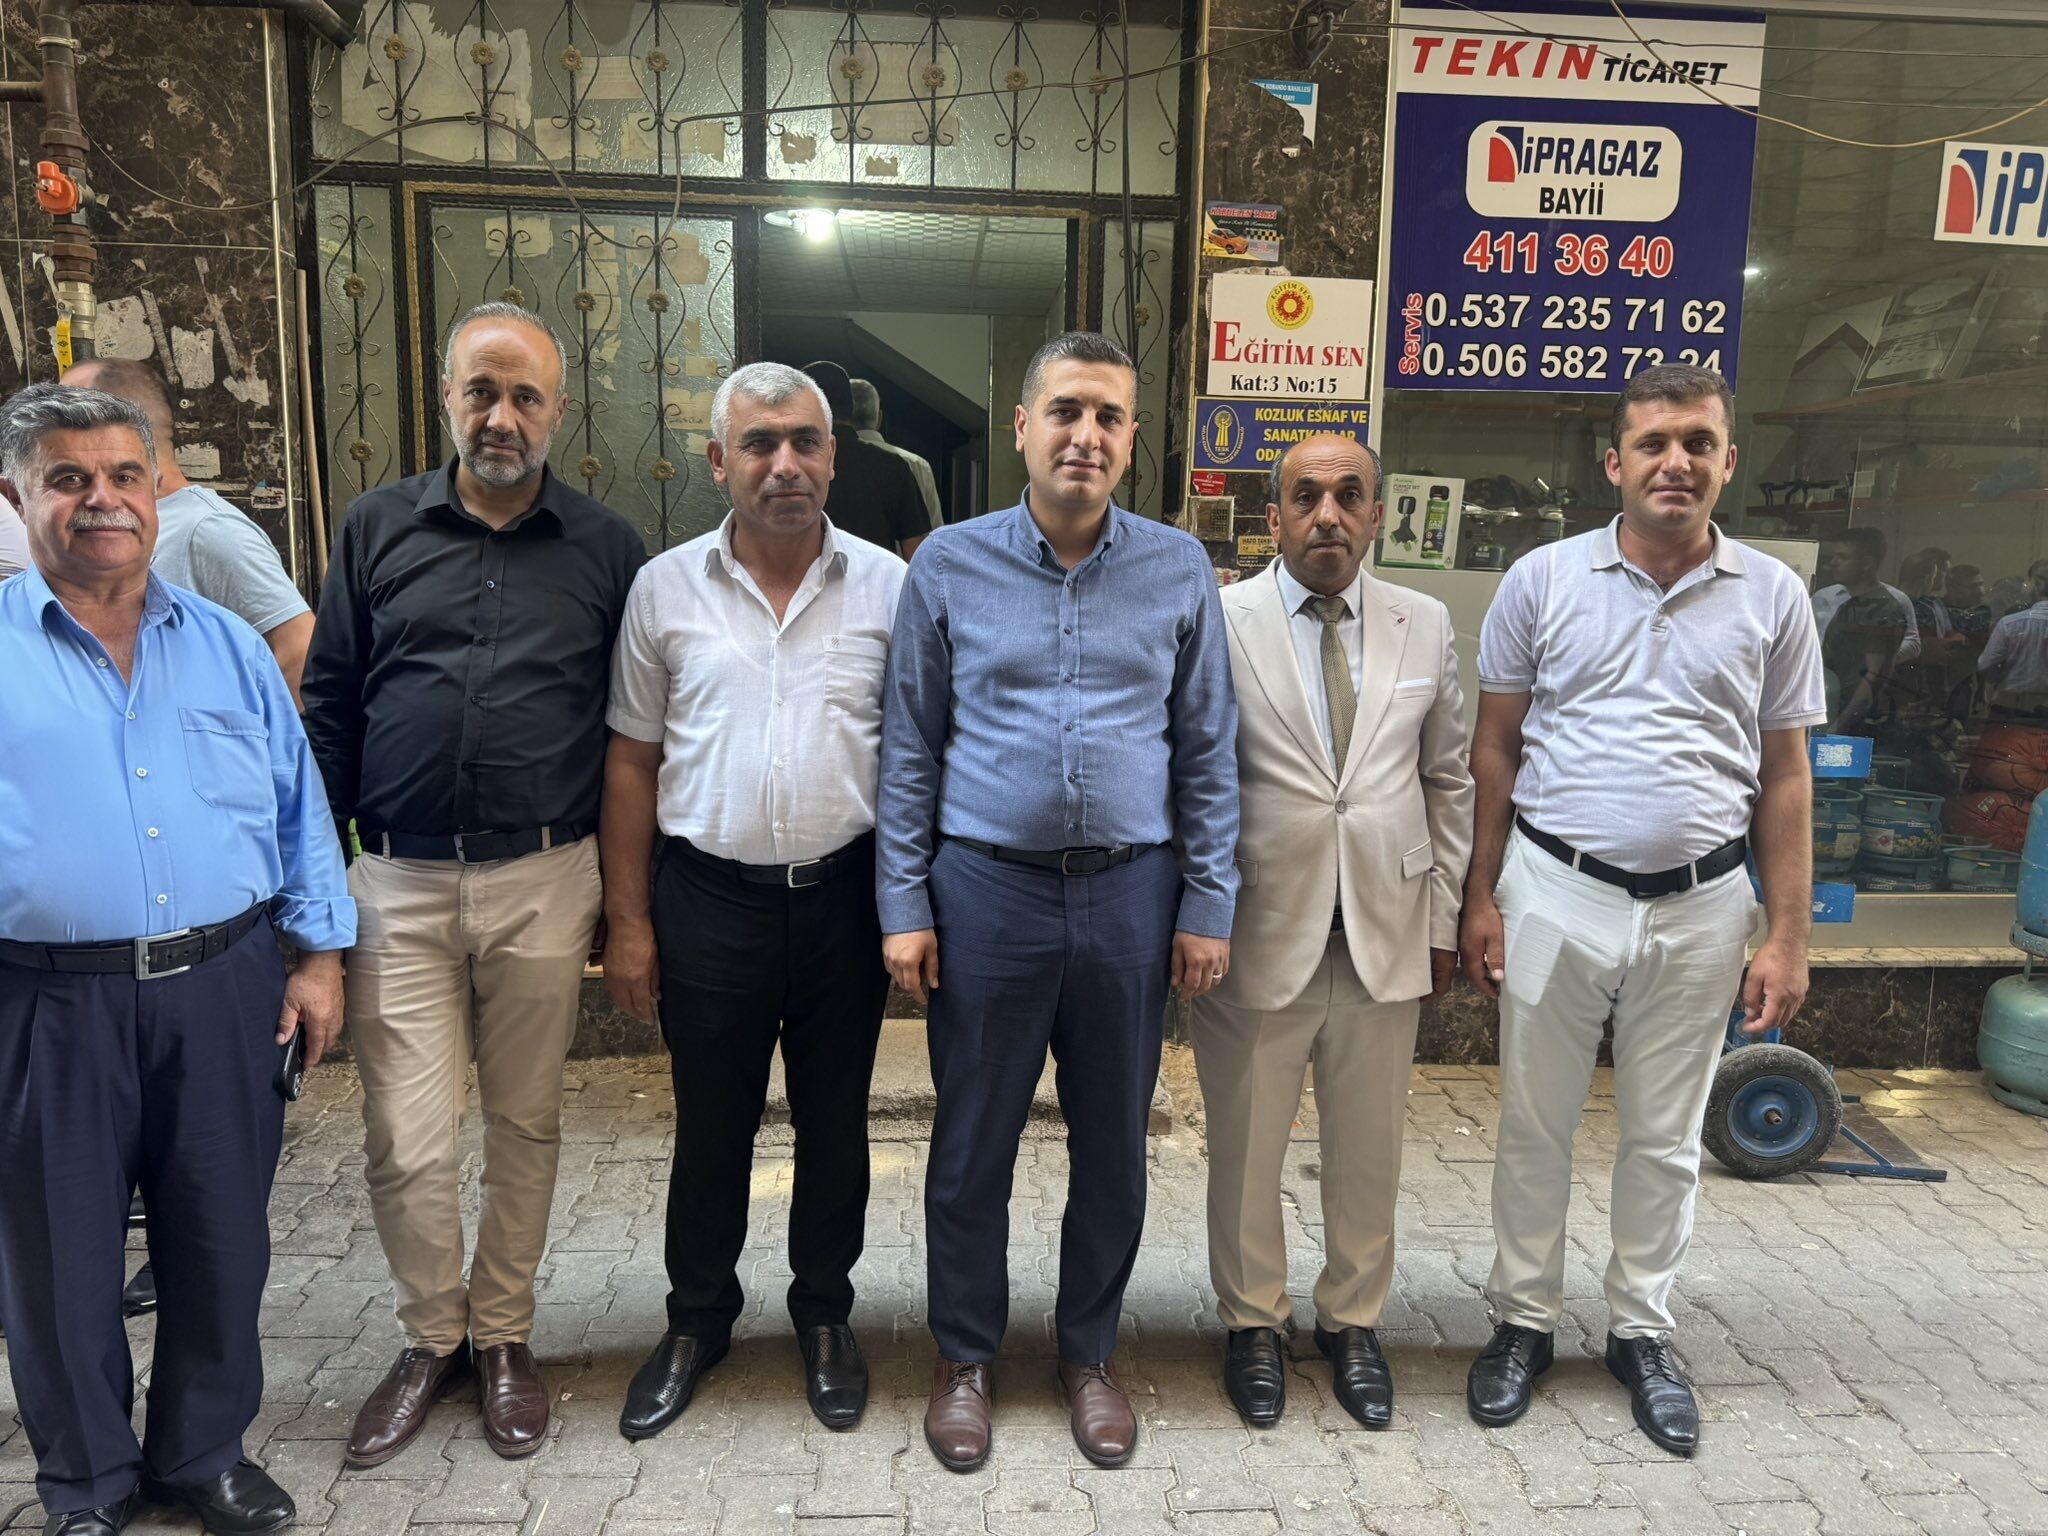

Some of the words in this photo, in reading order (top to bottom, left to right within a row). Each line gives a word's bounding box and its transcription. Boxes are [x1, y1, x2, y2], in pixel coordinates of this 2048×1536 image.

[1603, 53, 1728, 86] TİCARET
[1464, 230, 1538, 273] 411
[1554, 233, 1609, 276] 36
[1619, 235, 1674, 278] 40
[1425, 292, 1531, 328] 0.537
[1541, 295, 1611, 331] 235
[1625, 298, 1665, 332] 71
[1681, 299, 1727, 334] 62
[1398, 292, 1424, 375] Servis
[1321, 345, 1365, 367] SEN
[1422, 342, 1527, 377] 0.506
[1539, 345, 1608, 379] 582
[1231, 374, 1279, 392] Kat:3
[1285, 376, 1337, 394] No:15
[1255, 408, 1304, 422] KOZLUK
[1307, 409, 1348, 423] ESNAF
[1351, 410, 1367, 424] VE
